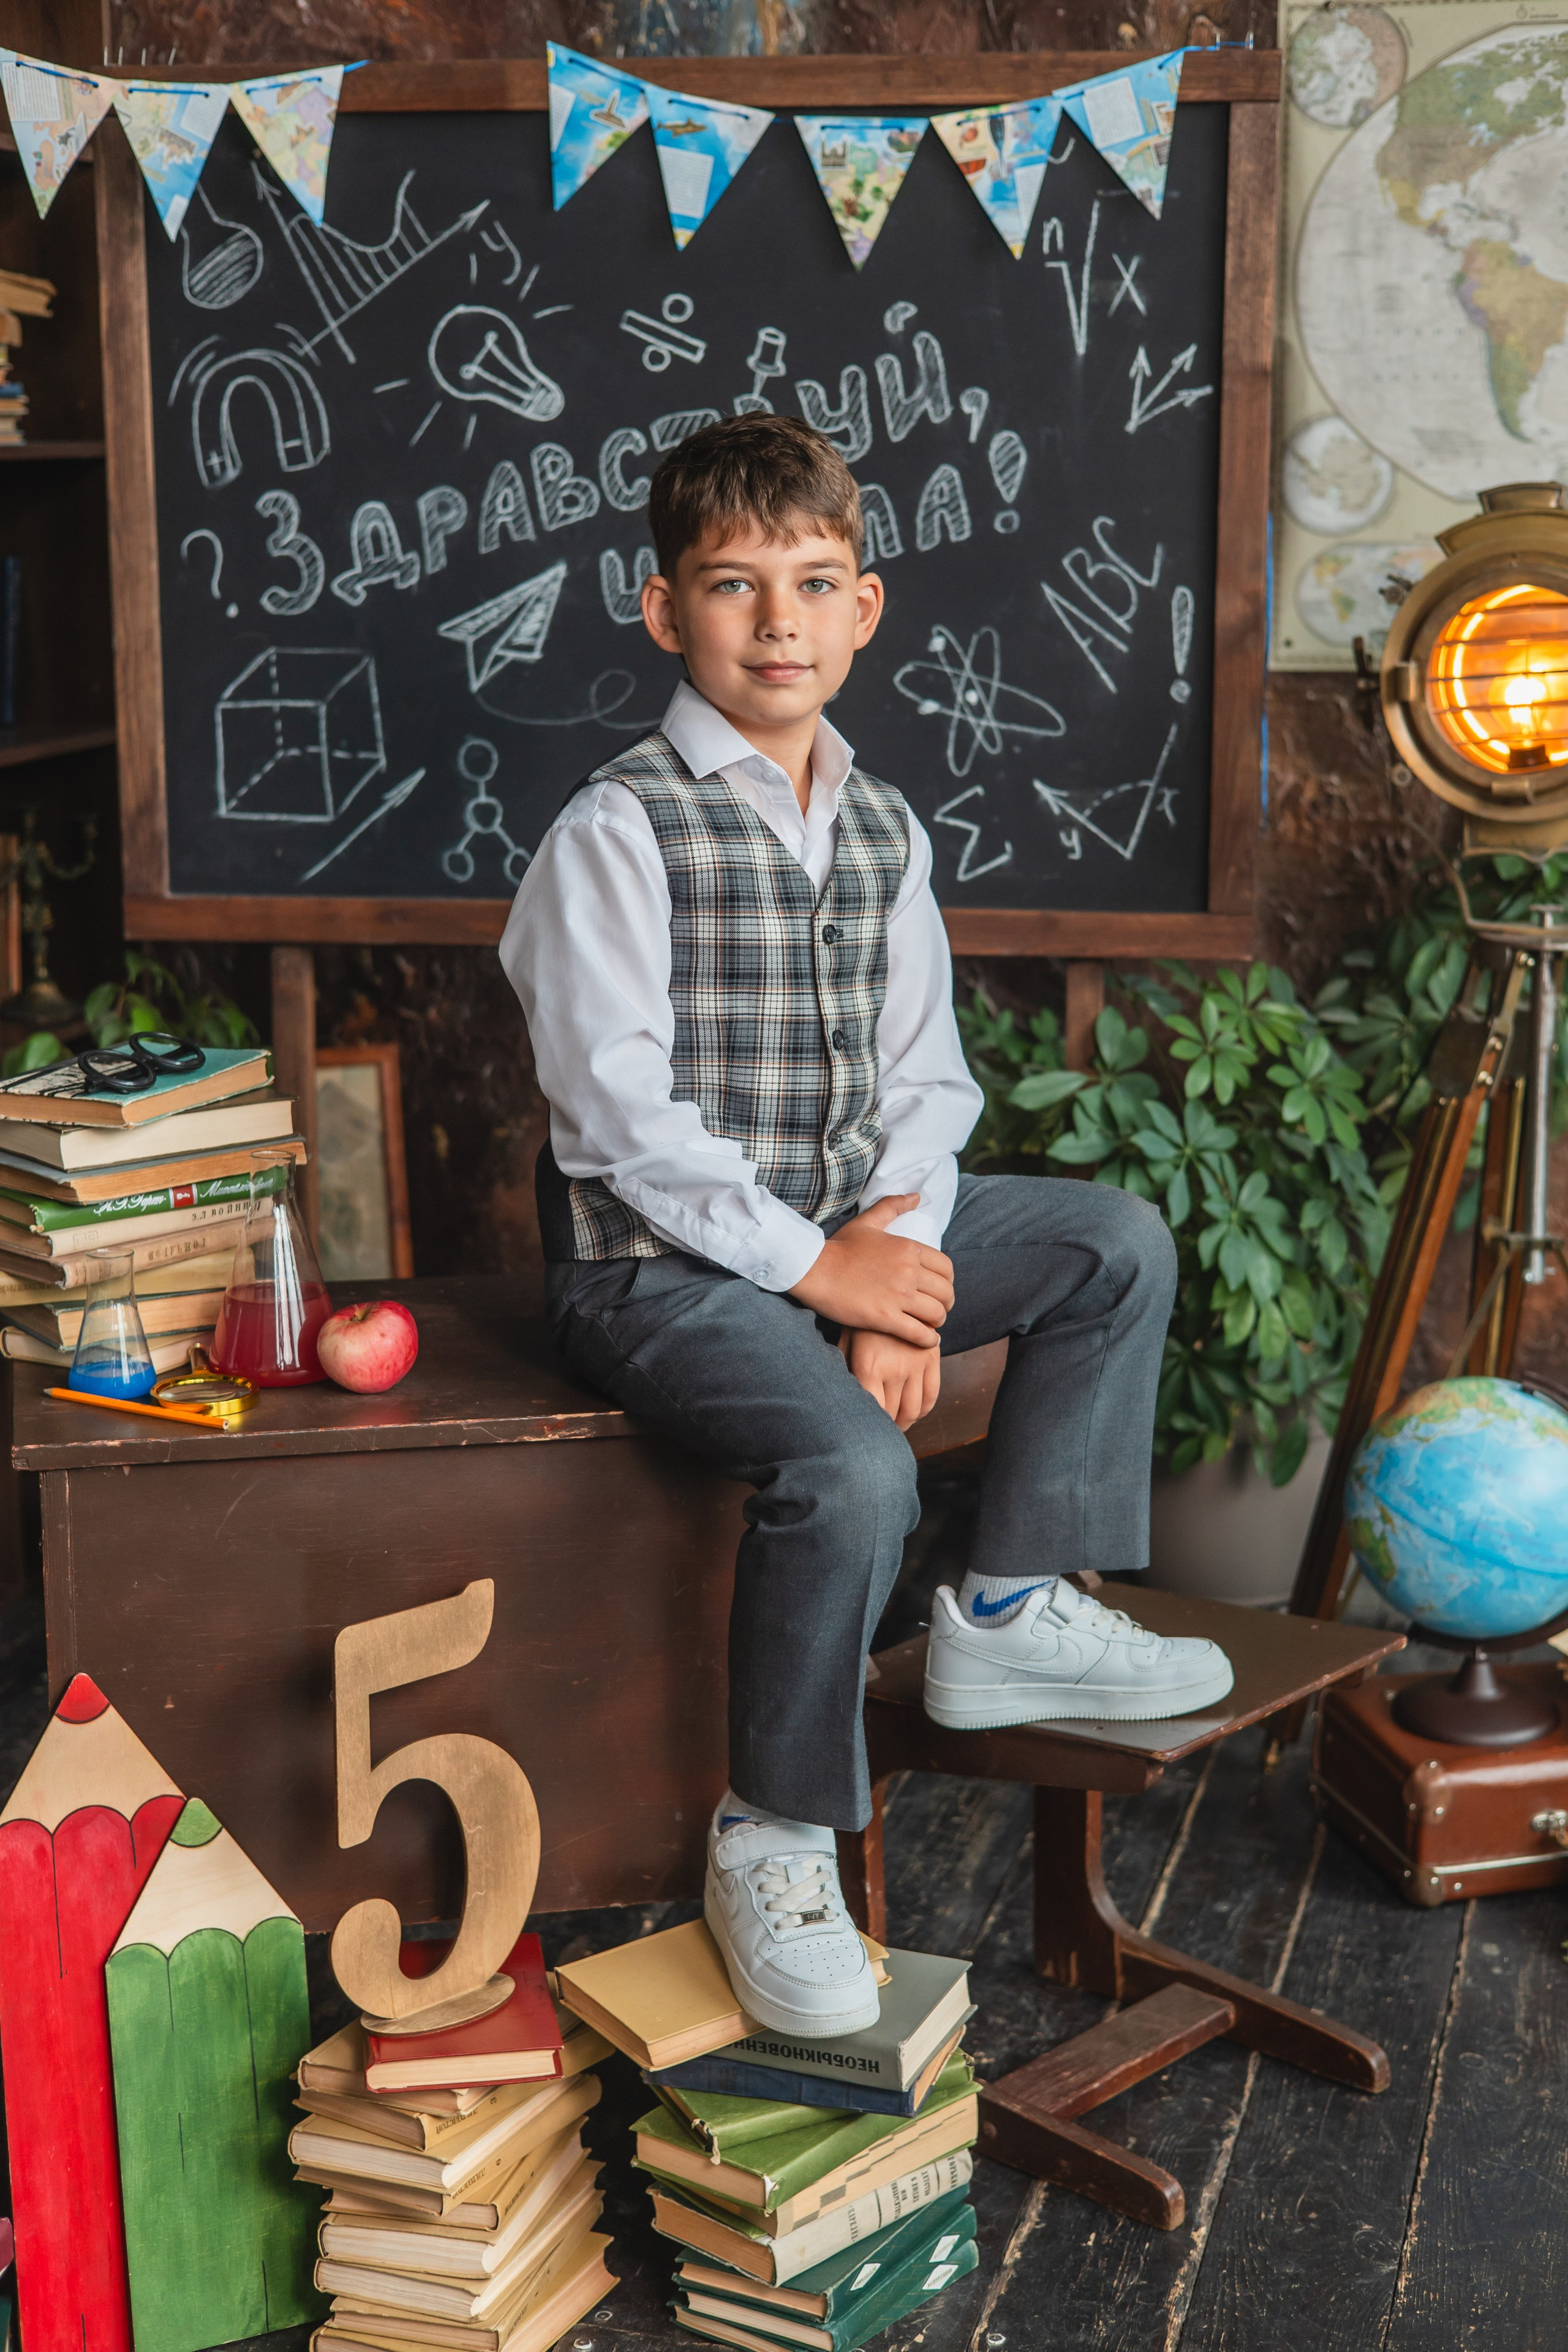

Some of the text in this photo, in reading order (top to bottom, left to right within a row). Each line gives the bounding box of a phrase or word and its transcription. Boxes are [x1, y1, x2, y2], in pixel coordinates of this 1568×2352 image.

[1041, 516, 1165, 693] ABC
[331, 1578, 542, 2019] 5
[725, 2038, 880, 2074] НЕОБЫКНОВЕНН
